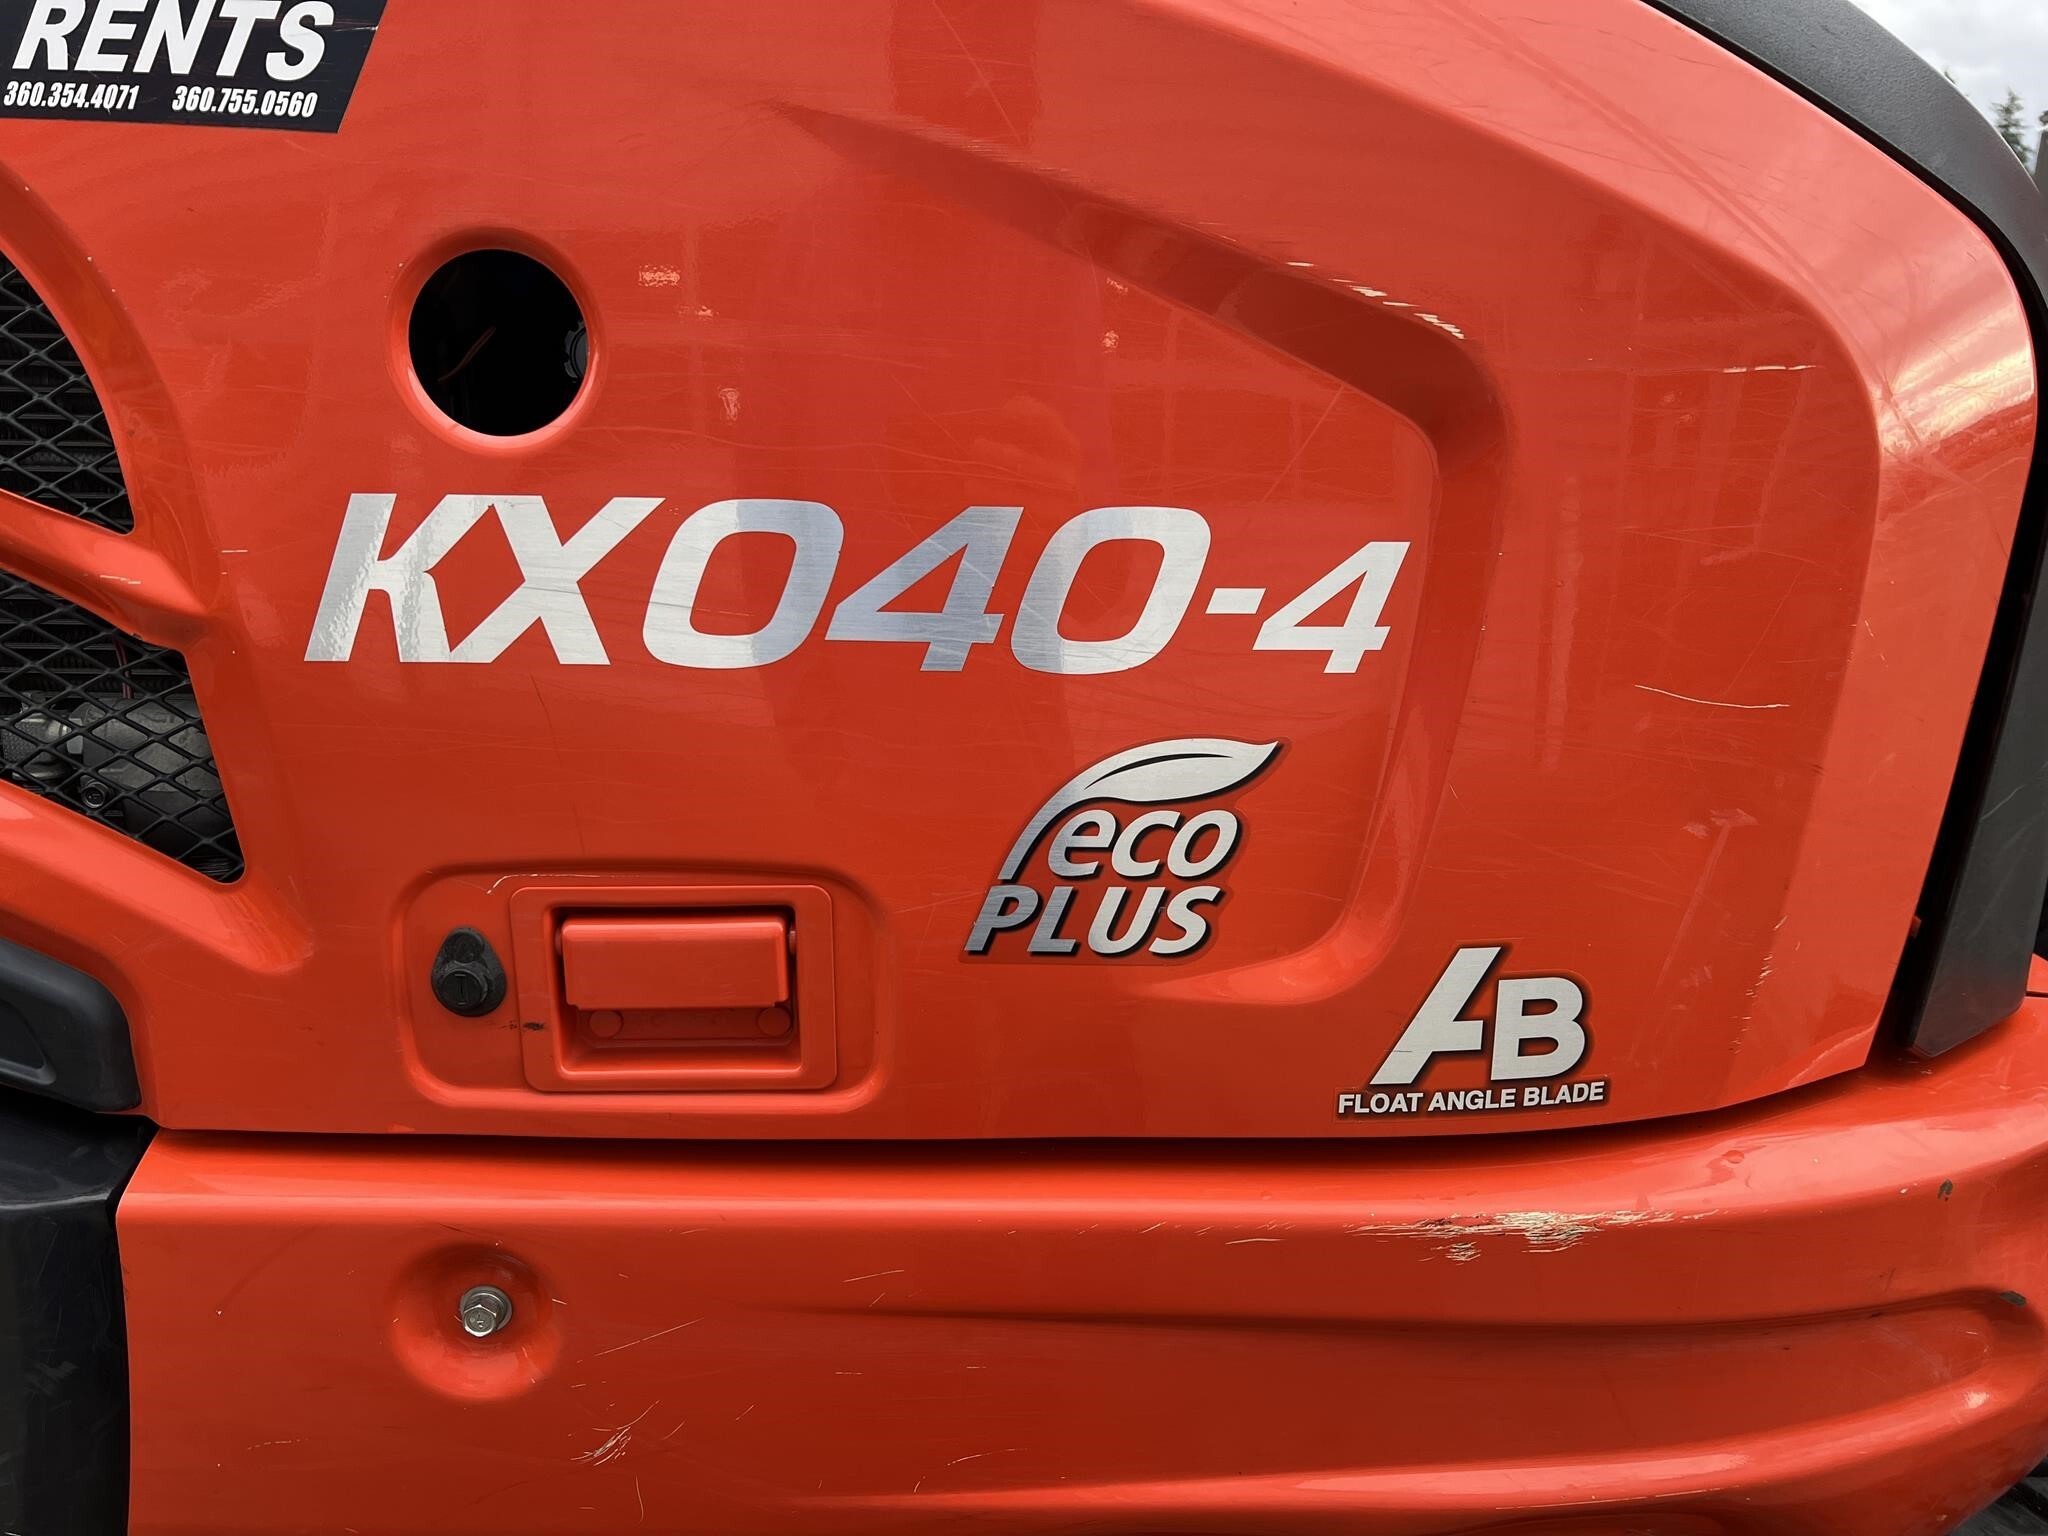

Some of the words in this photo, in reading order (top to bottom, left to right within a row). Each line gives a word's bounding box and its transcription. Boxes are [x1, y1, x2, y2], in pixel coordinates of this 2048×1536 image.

[12, 0, 335, 81] RENTS
[4, 81, 140, 110] 360.354.4071
[172, 86, 318, 118] 360.755.0560
[304, 493, 1412, 675] KX040-4
[1048, 809, 1238, 877] eco
[964, 884, 1222, 954] PLUS
[1369, 946, 1586, 1085] AB
[1338, 1092, 1423, 1113] FLOAT
[1428, 1088, 1517, 1111] ANGLE
[1523, 1081, 1605, 1106] BLADE
